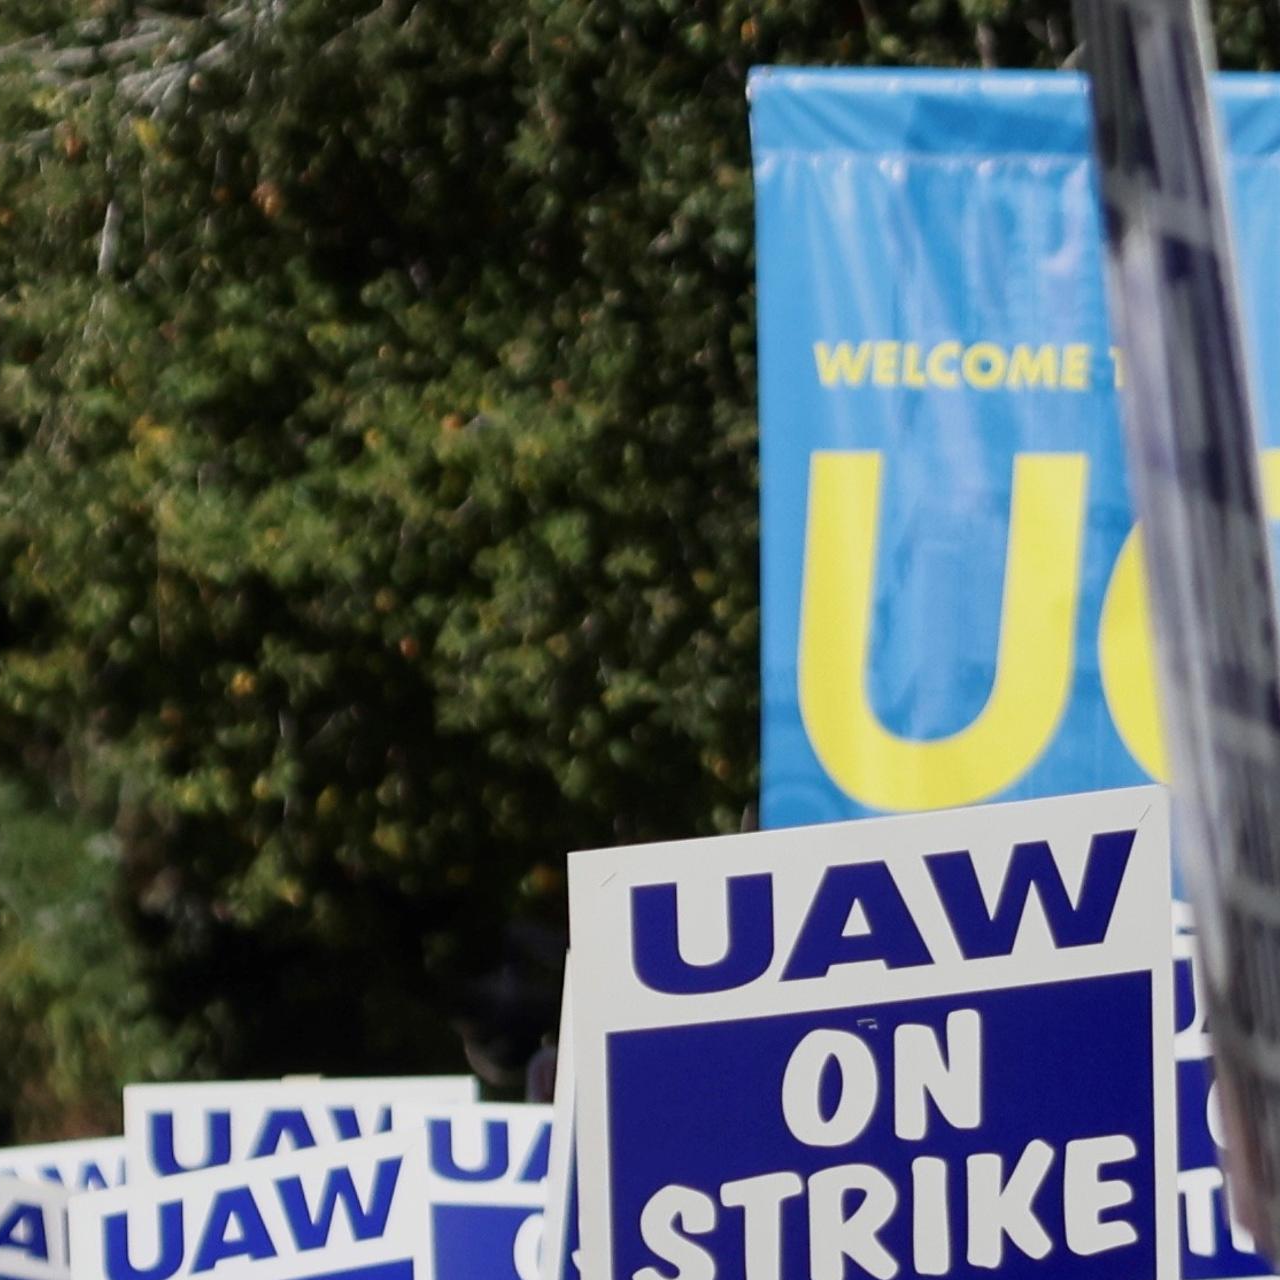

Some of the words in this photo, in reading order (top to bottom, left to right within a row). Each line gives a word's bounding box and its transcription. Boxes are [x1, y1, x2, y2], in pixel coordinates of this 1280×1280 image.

[813, 340, 1093, 391] WELCOME
[629, 827, 1139, 995] UAW
[779, 1007, 983, 1149] ON
